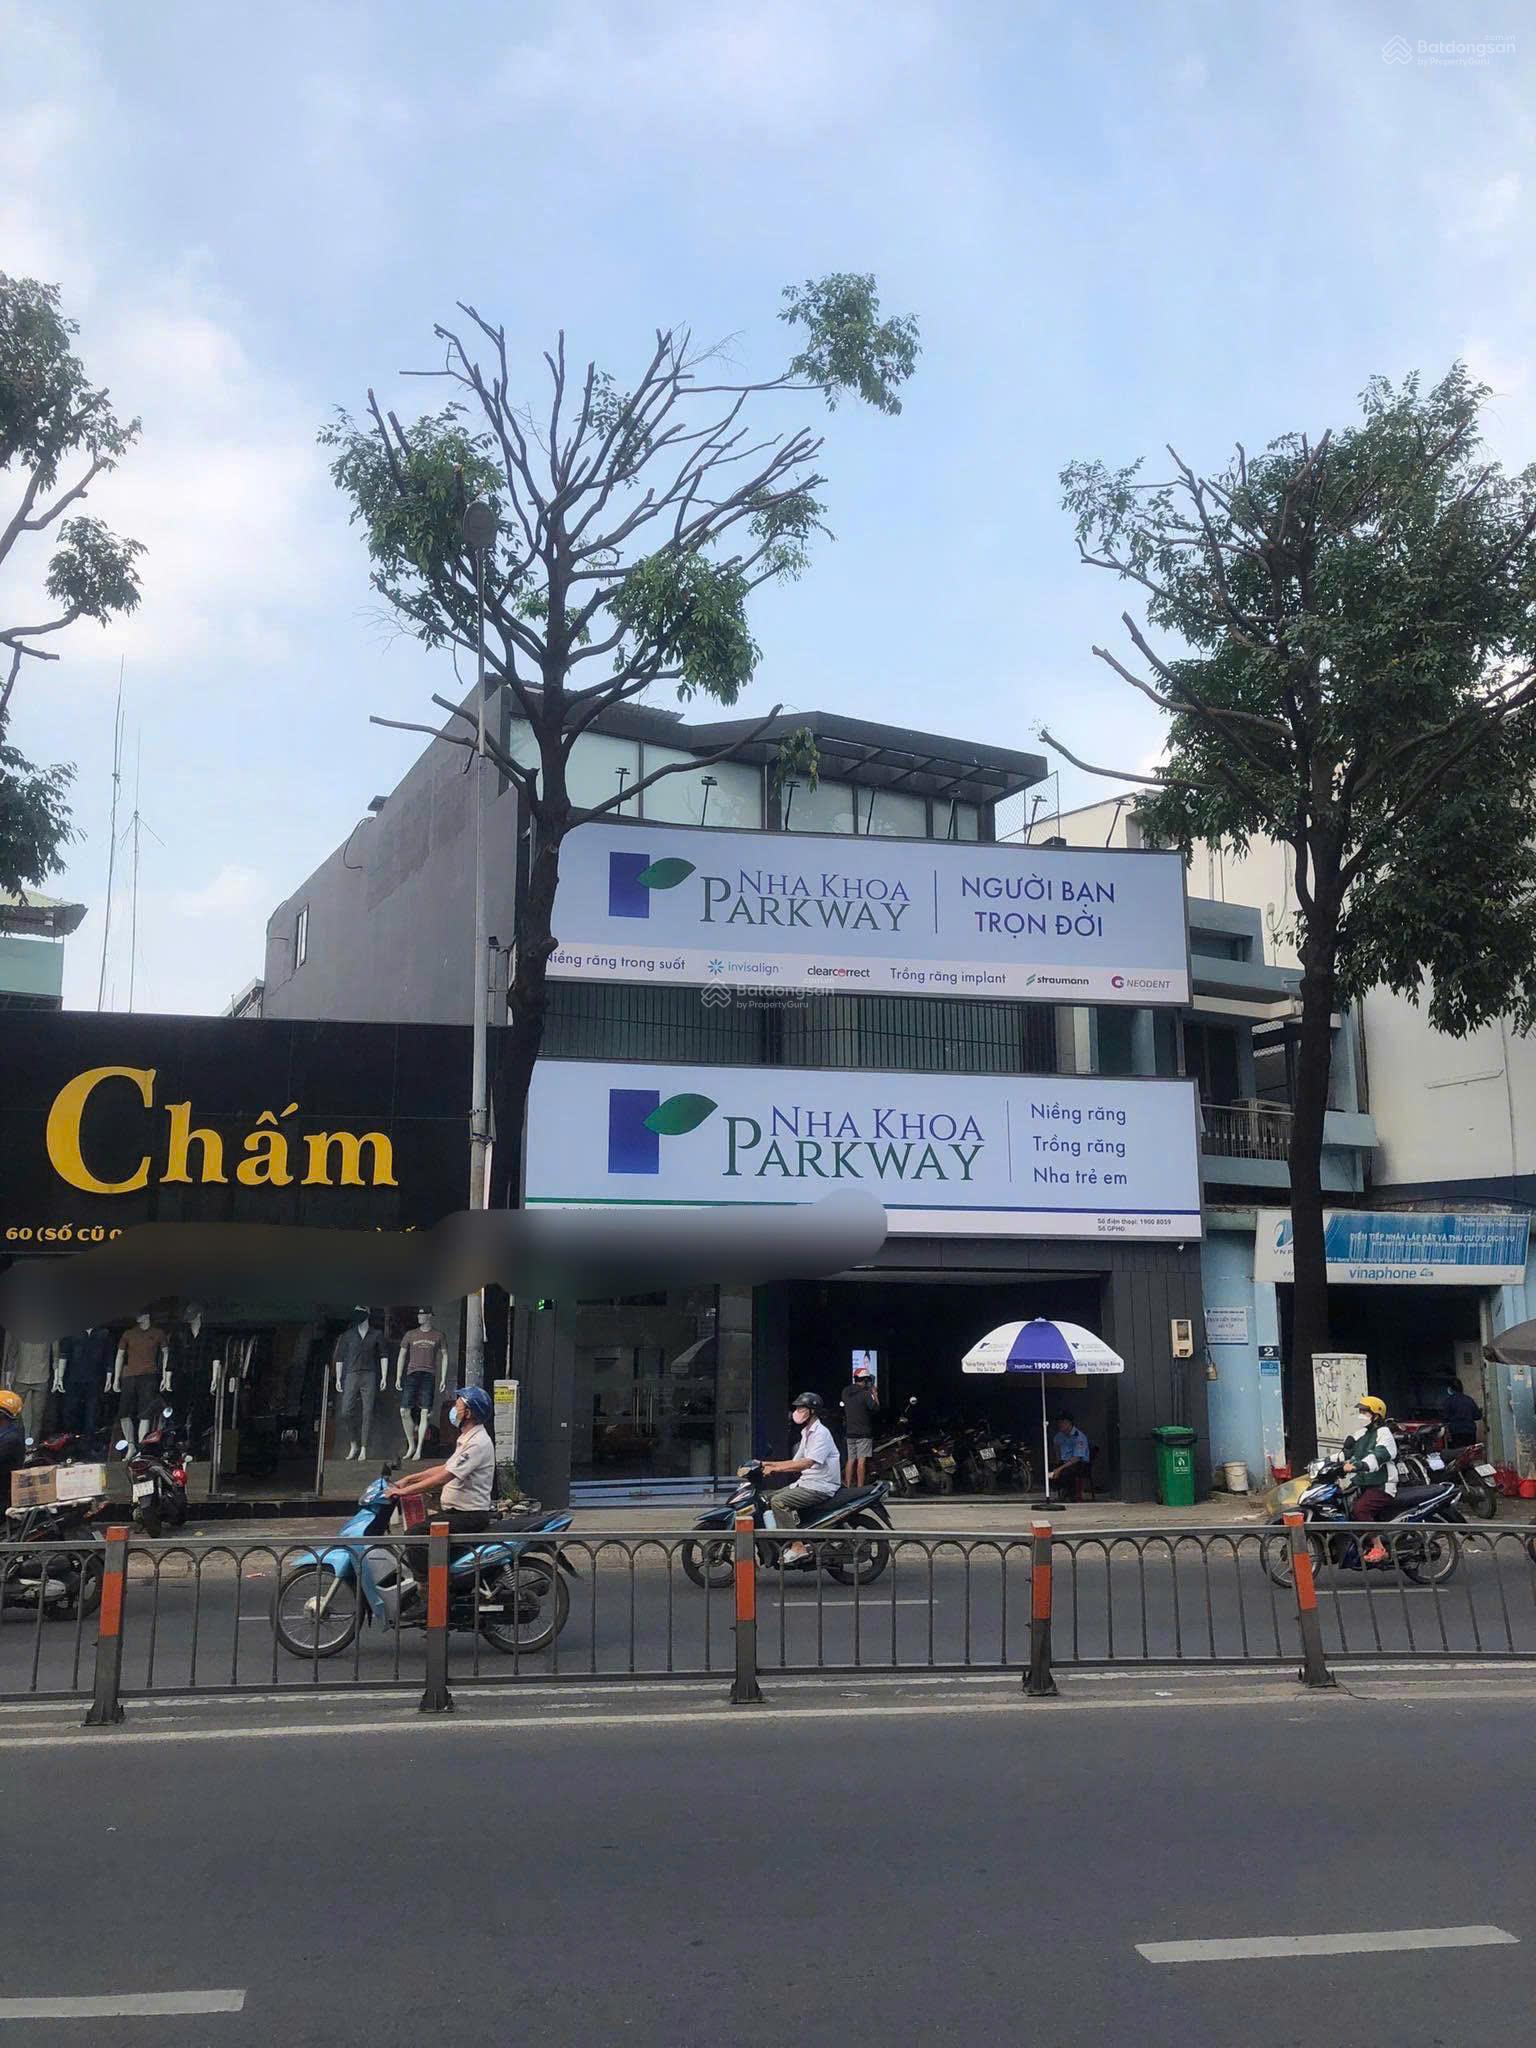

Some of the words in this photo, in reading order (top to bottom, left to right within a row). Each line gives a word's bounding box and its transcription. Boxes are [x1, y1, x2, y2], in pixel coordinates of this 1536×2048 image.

[961, 873, 1051, 901] NGƯỜI
[1062, 881, 1115, 908] BẠN
[974, 911, 1047, 939] TRỌN
[1055, 909, 1103, 937] ĐỜI
[586, 955, 617, 970] răng
[621, 957, 655, 972] trong
[659, 956, 686, 970] suốt
[728, 960, 780, 976] invisalign
[807, 964, 870, 978] clearcorrect
[890, 965, 926, 984] Trồng
[929, 970, 958, 985] răng
[961, 971, 1007, 986] implant
[1037, 974, 1090, 986] straumann
[1126, 979, 1171, 989] NEODENT
[1031, 1102, 1082, 1125] Niềng
[1088, 1107, 1127, 1126] răng
[46, 1065, 399, 1195] Chấm
[1033, 1134, 1081, 1157] Trồng
[1087, 1139, 1126, 1158] răng
[1033, 1166, 1070, 1184] Nha
[1075, 1168, 1098, 1185] trẻ
[1103, 1173, 1128, 1185] em
[6, 1227, 33, 1240] 60
[36, 1223, 73, 1242] (SỐ
[77, 1225, 105, 1241] CŨ
[1348, 1266, 1417, 1280] vinaphone
[1264, 1346, 1274, 1357] 2
[1033, 1362, 1050, 1370] 1900
[1051, 1362, 1069, 1370] 8059
